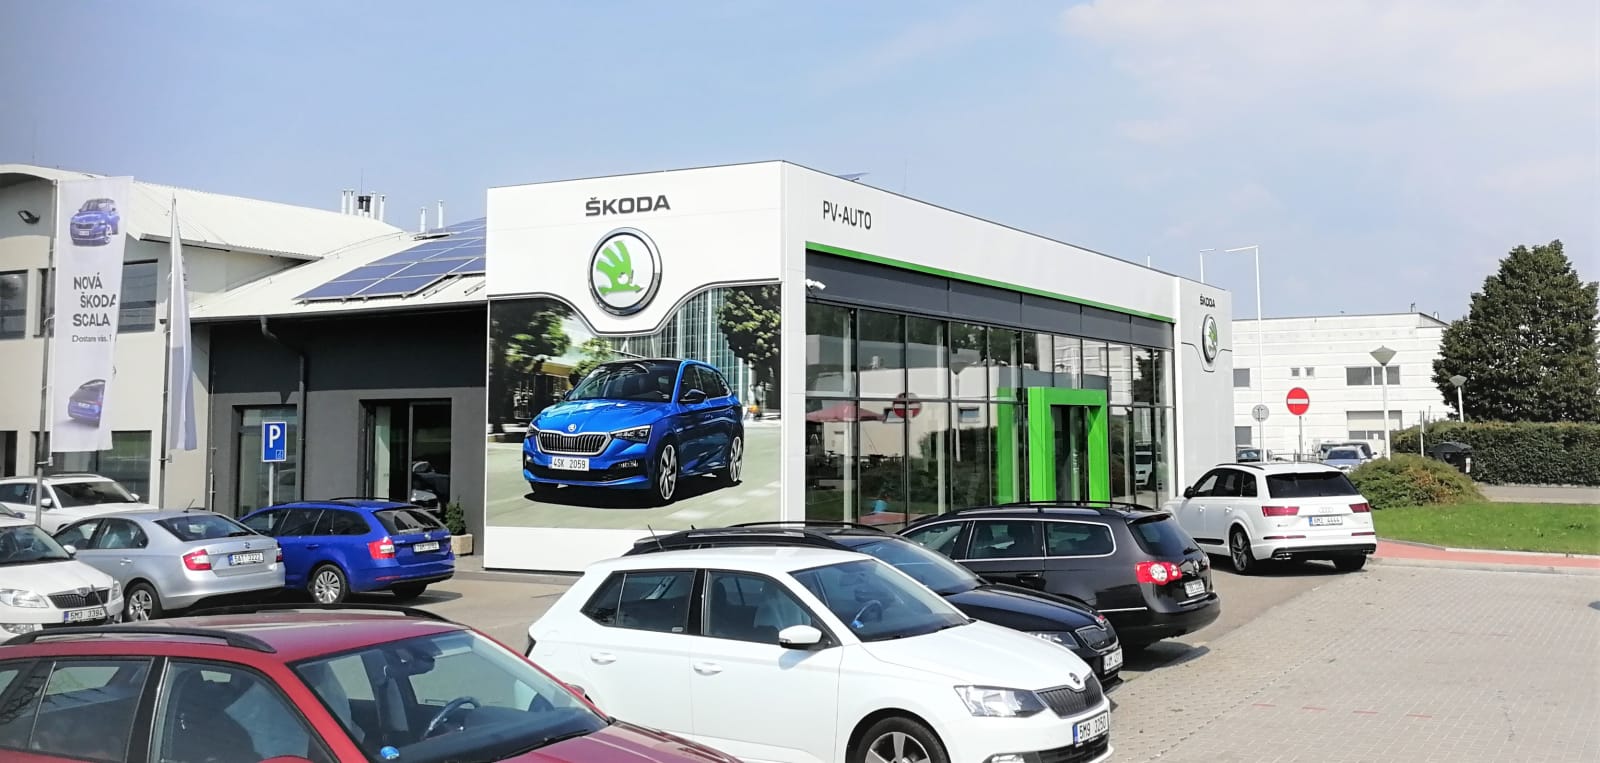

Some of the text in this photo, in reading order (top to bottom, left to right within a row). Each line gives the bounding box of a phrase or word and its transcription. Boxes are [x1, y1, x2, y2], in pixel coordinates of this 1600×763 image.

[585, 194, 671, 216] ŠKODA
[823, 200, 872, 230] PV-AUTO
[73, 272, 103, 290] NOVÁ
[80, 291, 117, 308] ŠKODA
[73, 313, 111, 327] SCALA
[269, 424, 281, 449] P
[553, 458, 586, 469] 4SK 2059
[1079, 721, 1091, 739] 5M9
